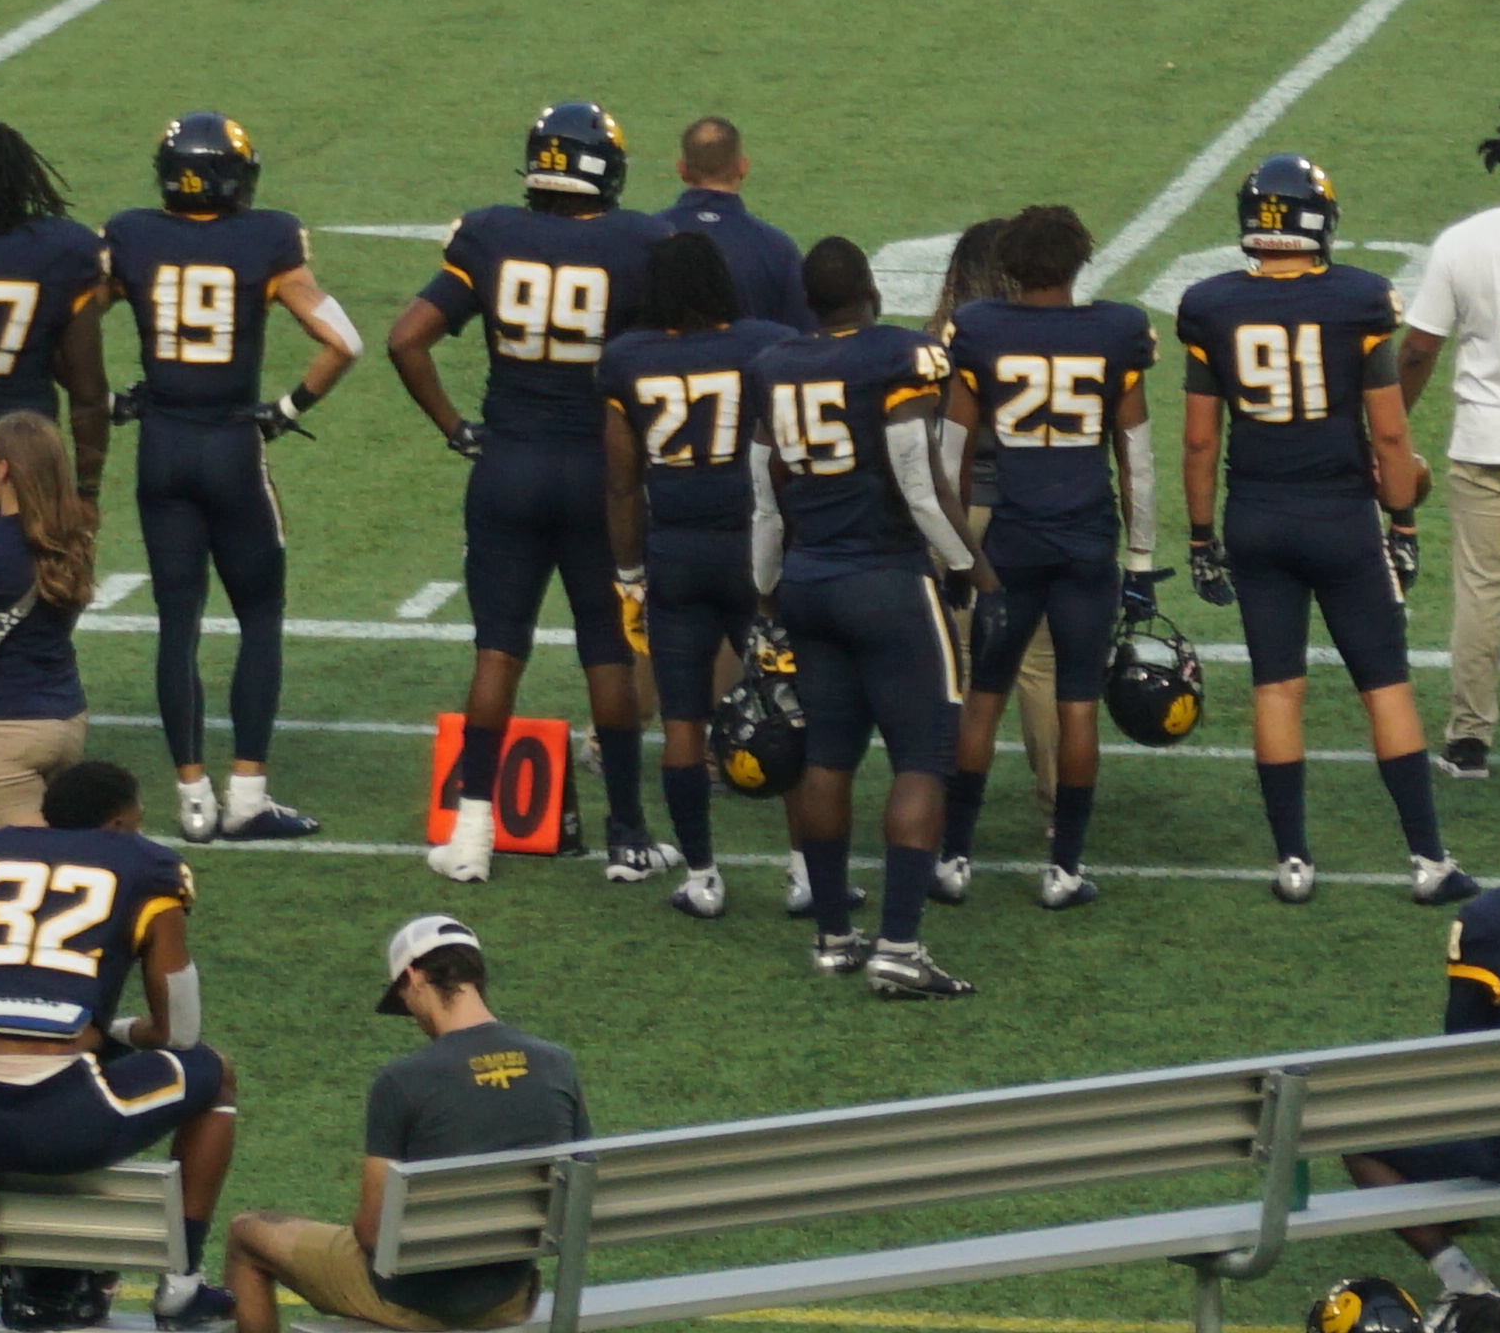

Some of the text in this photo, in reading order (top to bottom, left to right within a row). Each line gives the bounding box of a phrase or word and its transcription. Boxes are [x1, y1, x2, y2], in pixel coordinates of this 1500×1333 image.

[1259, 210, 1285, 230] 91
[151, 263, 236, 364] 19
[496, 261, 612, 364] 99
[912, 346, 952, 380] 45
[994, 355, 1105, 448] 25
[1234, 322, 1329, 423] 91
[634, 370, 743, 467] 27
[770, 380, 856, 475] 45
